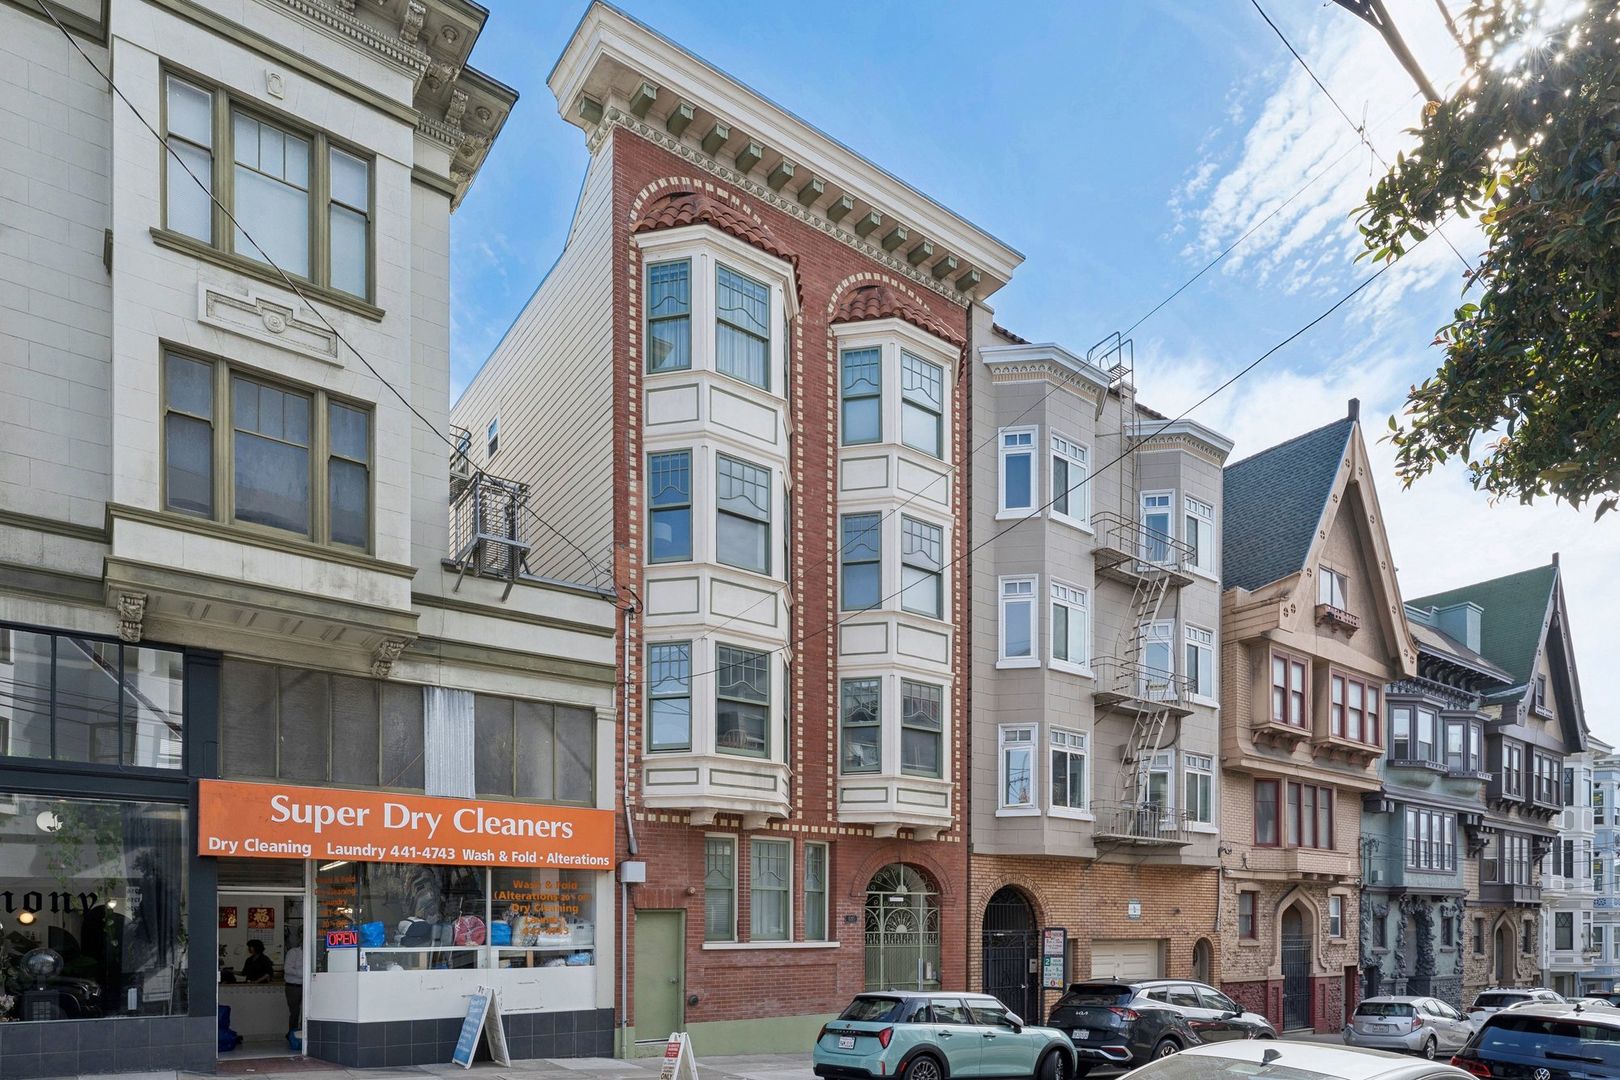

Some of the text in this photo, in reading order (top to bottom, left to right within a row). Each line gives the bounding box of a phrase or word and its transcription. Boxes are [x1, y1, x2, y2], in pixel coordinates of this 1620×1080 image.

[270, 793, 574, 840] Super Dry Cleaners
[208, 836, 312, 857] Dry Cleaning
[326, 841, 456, 860] Laundry 441-4743
[462, 848, 609, 866] Wash & Fold Alterations
[513, 879, 541, 889] Wash
[511, 902, 531, 913] Dry
[328, 931, 358, 945] OPEN
